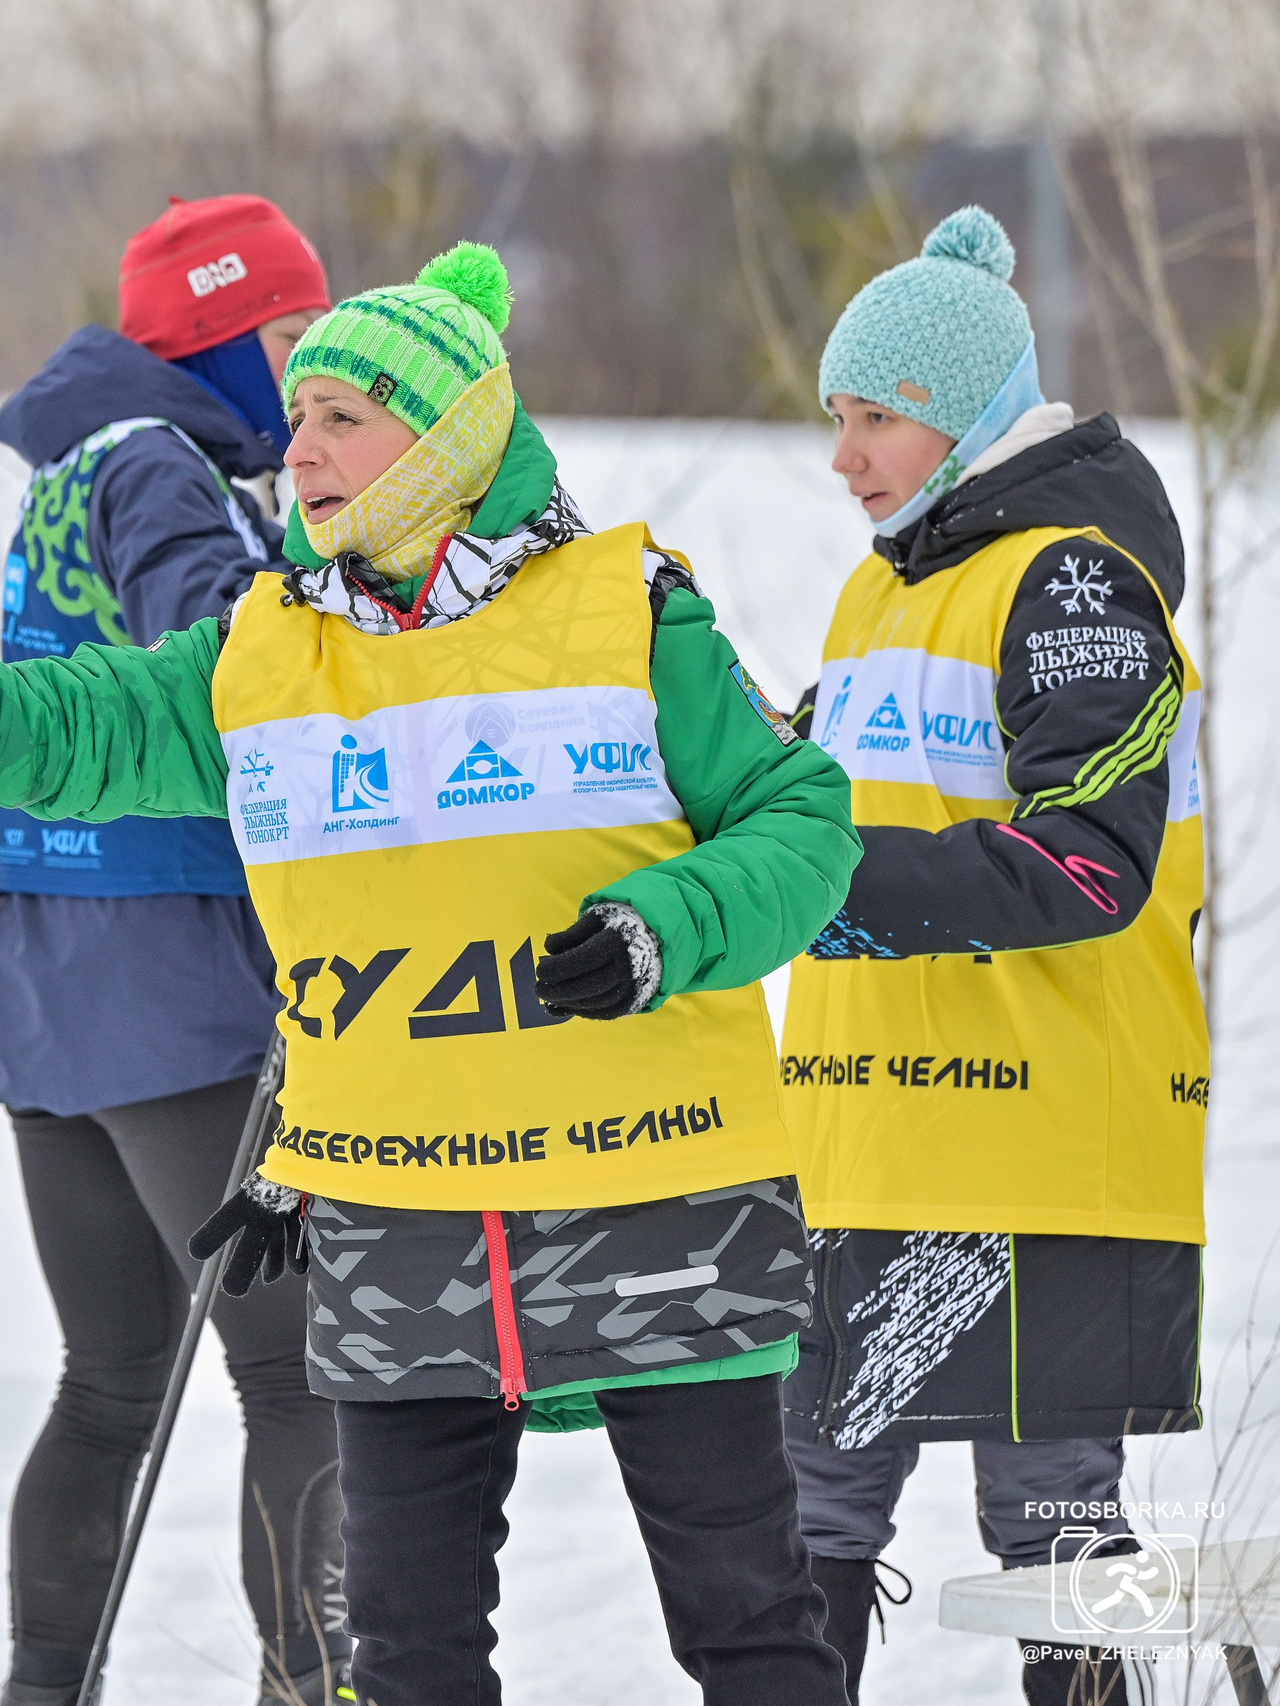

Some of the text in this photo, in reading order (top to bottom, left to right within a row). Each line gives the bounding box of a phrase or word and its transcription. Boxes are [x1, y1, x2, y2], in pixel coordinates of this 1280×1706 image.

[1026, 626, 1147, 650] ФЕДЕРАЦИЯ
[1028, 641, 1149, 673] ЛЫЖНЫХ
[240, 799, 287, 816] ФЕДЕРАЦИЯ
[437, 783, 535, 809] ДОМКОР
[243, 812, 288, 829] ЛЫЖНЫХ
[323, 816, 400, 833] АНГ-Холдинг
[287, 935, 574, 1041] СУДЬ
[780, 1055, 1028, 1090] ЕЖНЫЕ ЧЕЛНЫ
[567, 1096, 724, 1154] ЧЕЛНЫ
